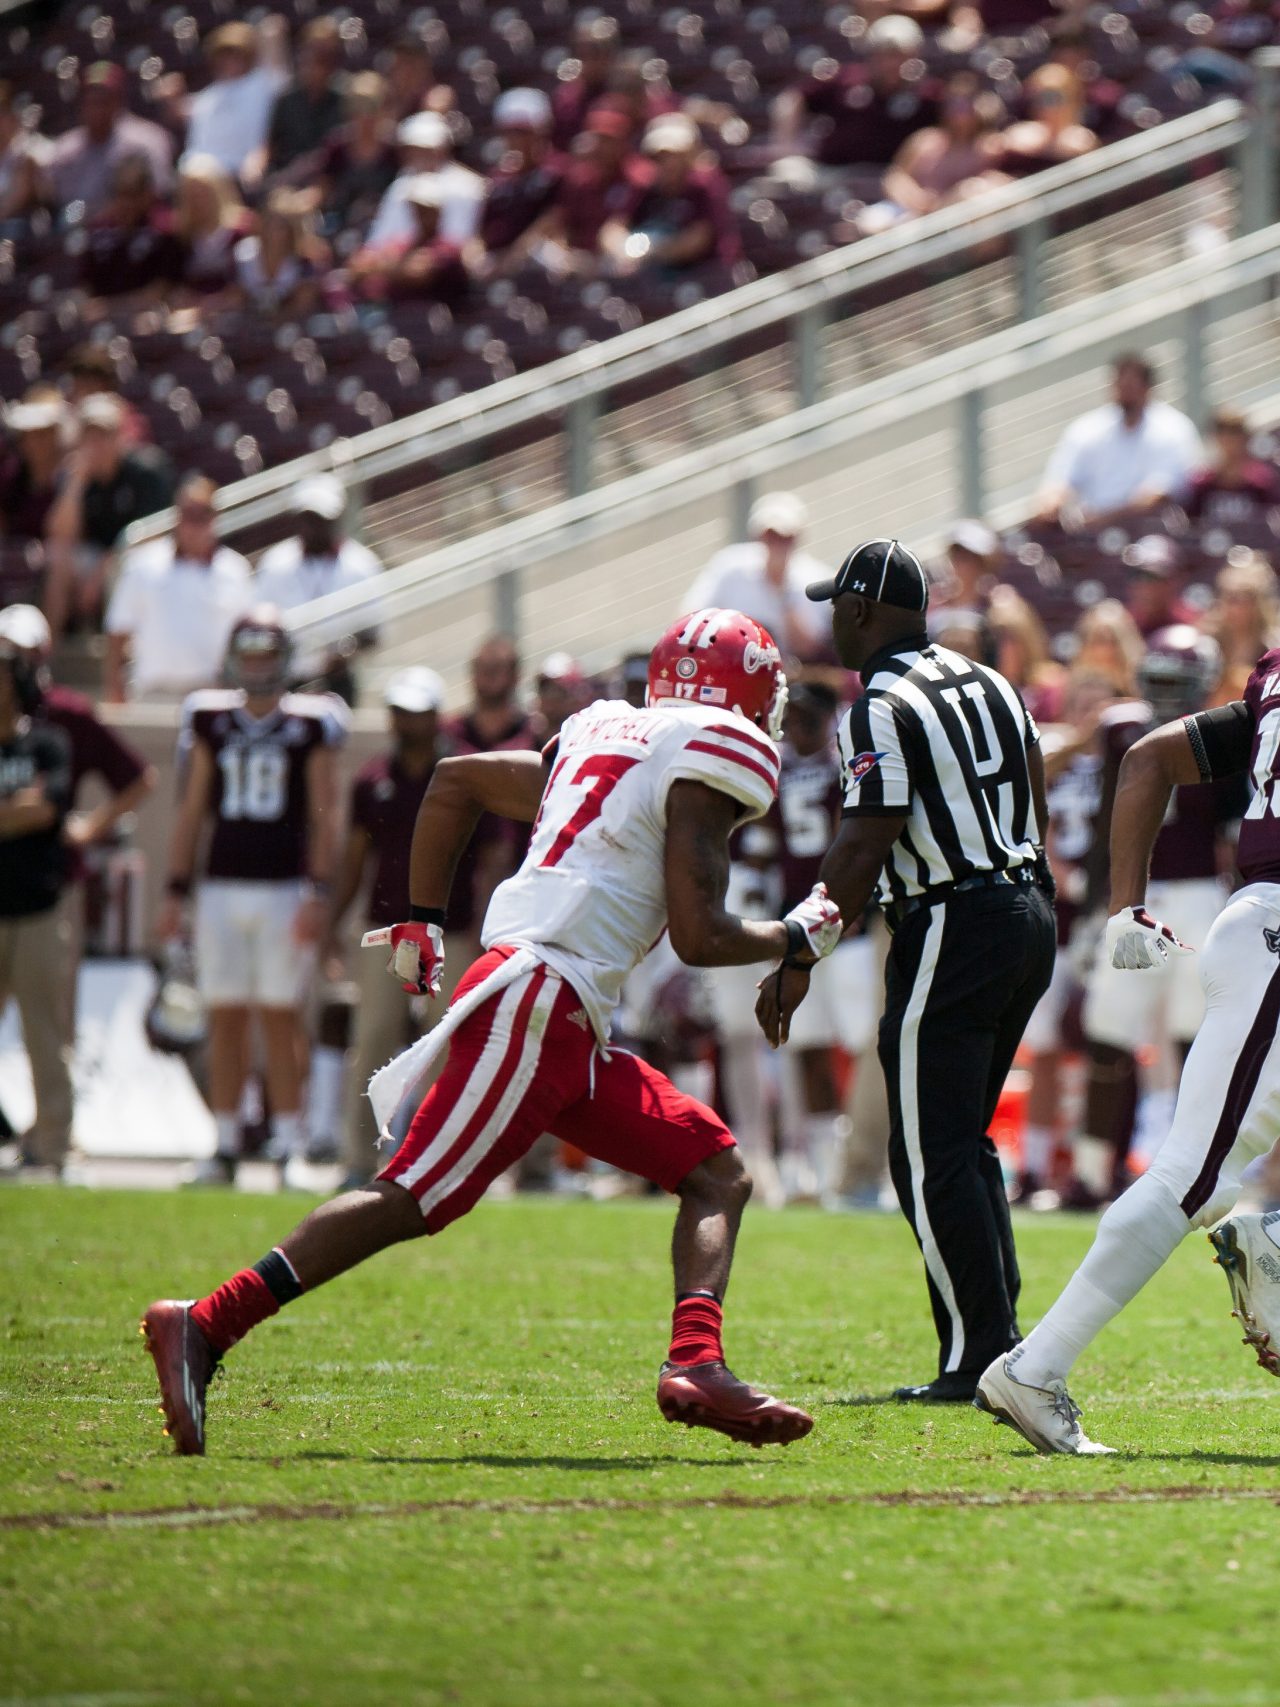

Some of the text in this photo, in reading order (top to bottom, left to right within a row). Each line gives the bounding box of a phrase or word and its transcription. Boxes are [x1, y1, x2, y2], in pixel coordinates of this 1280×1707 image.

[675, 682, 698, 699] 17
[940, 681, 1004, 778] U
[218, 745, 287, 821] 18
[533, 753, 643, 868] 17
